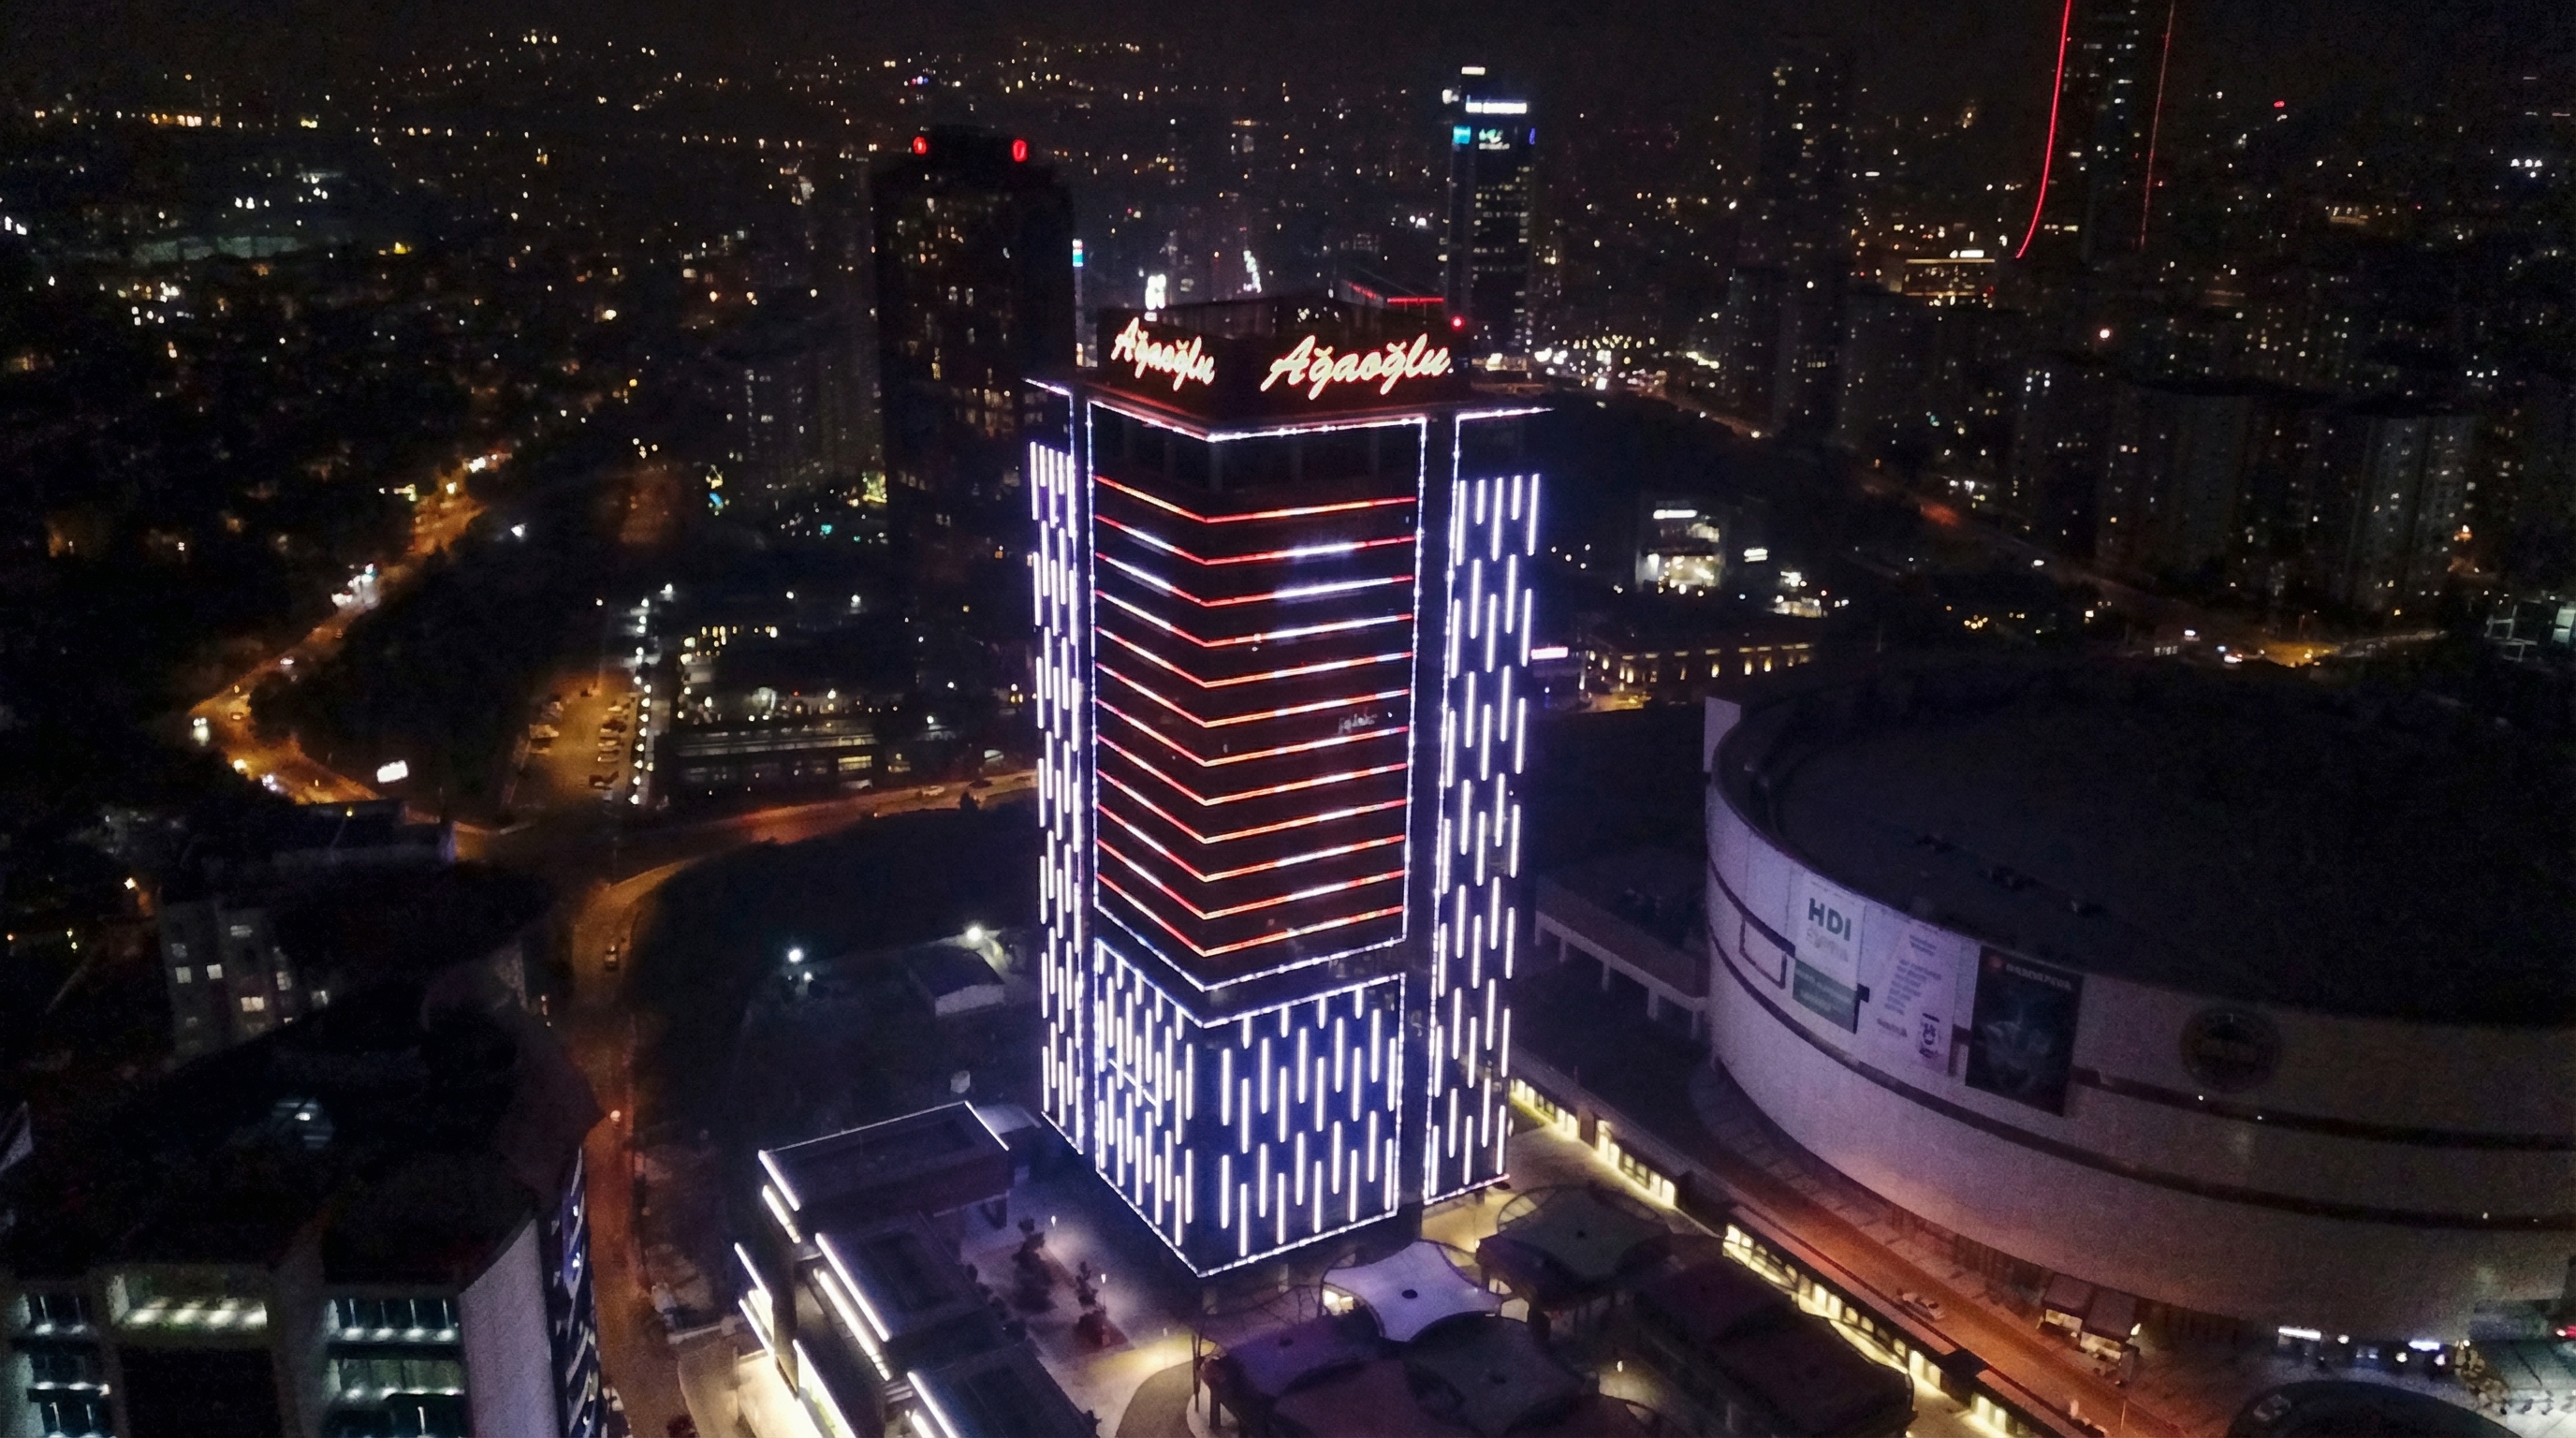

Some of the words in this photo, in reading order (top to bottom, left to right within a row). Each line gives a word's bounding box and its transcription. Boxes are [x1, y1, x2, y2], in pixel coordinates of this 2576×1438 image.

[1111, 317, 1216, 391] Ağaoğlu
[1260, 333, 1450, 400] Ağaoğlu
[1808, 898, 1852, 942] HDI
